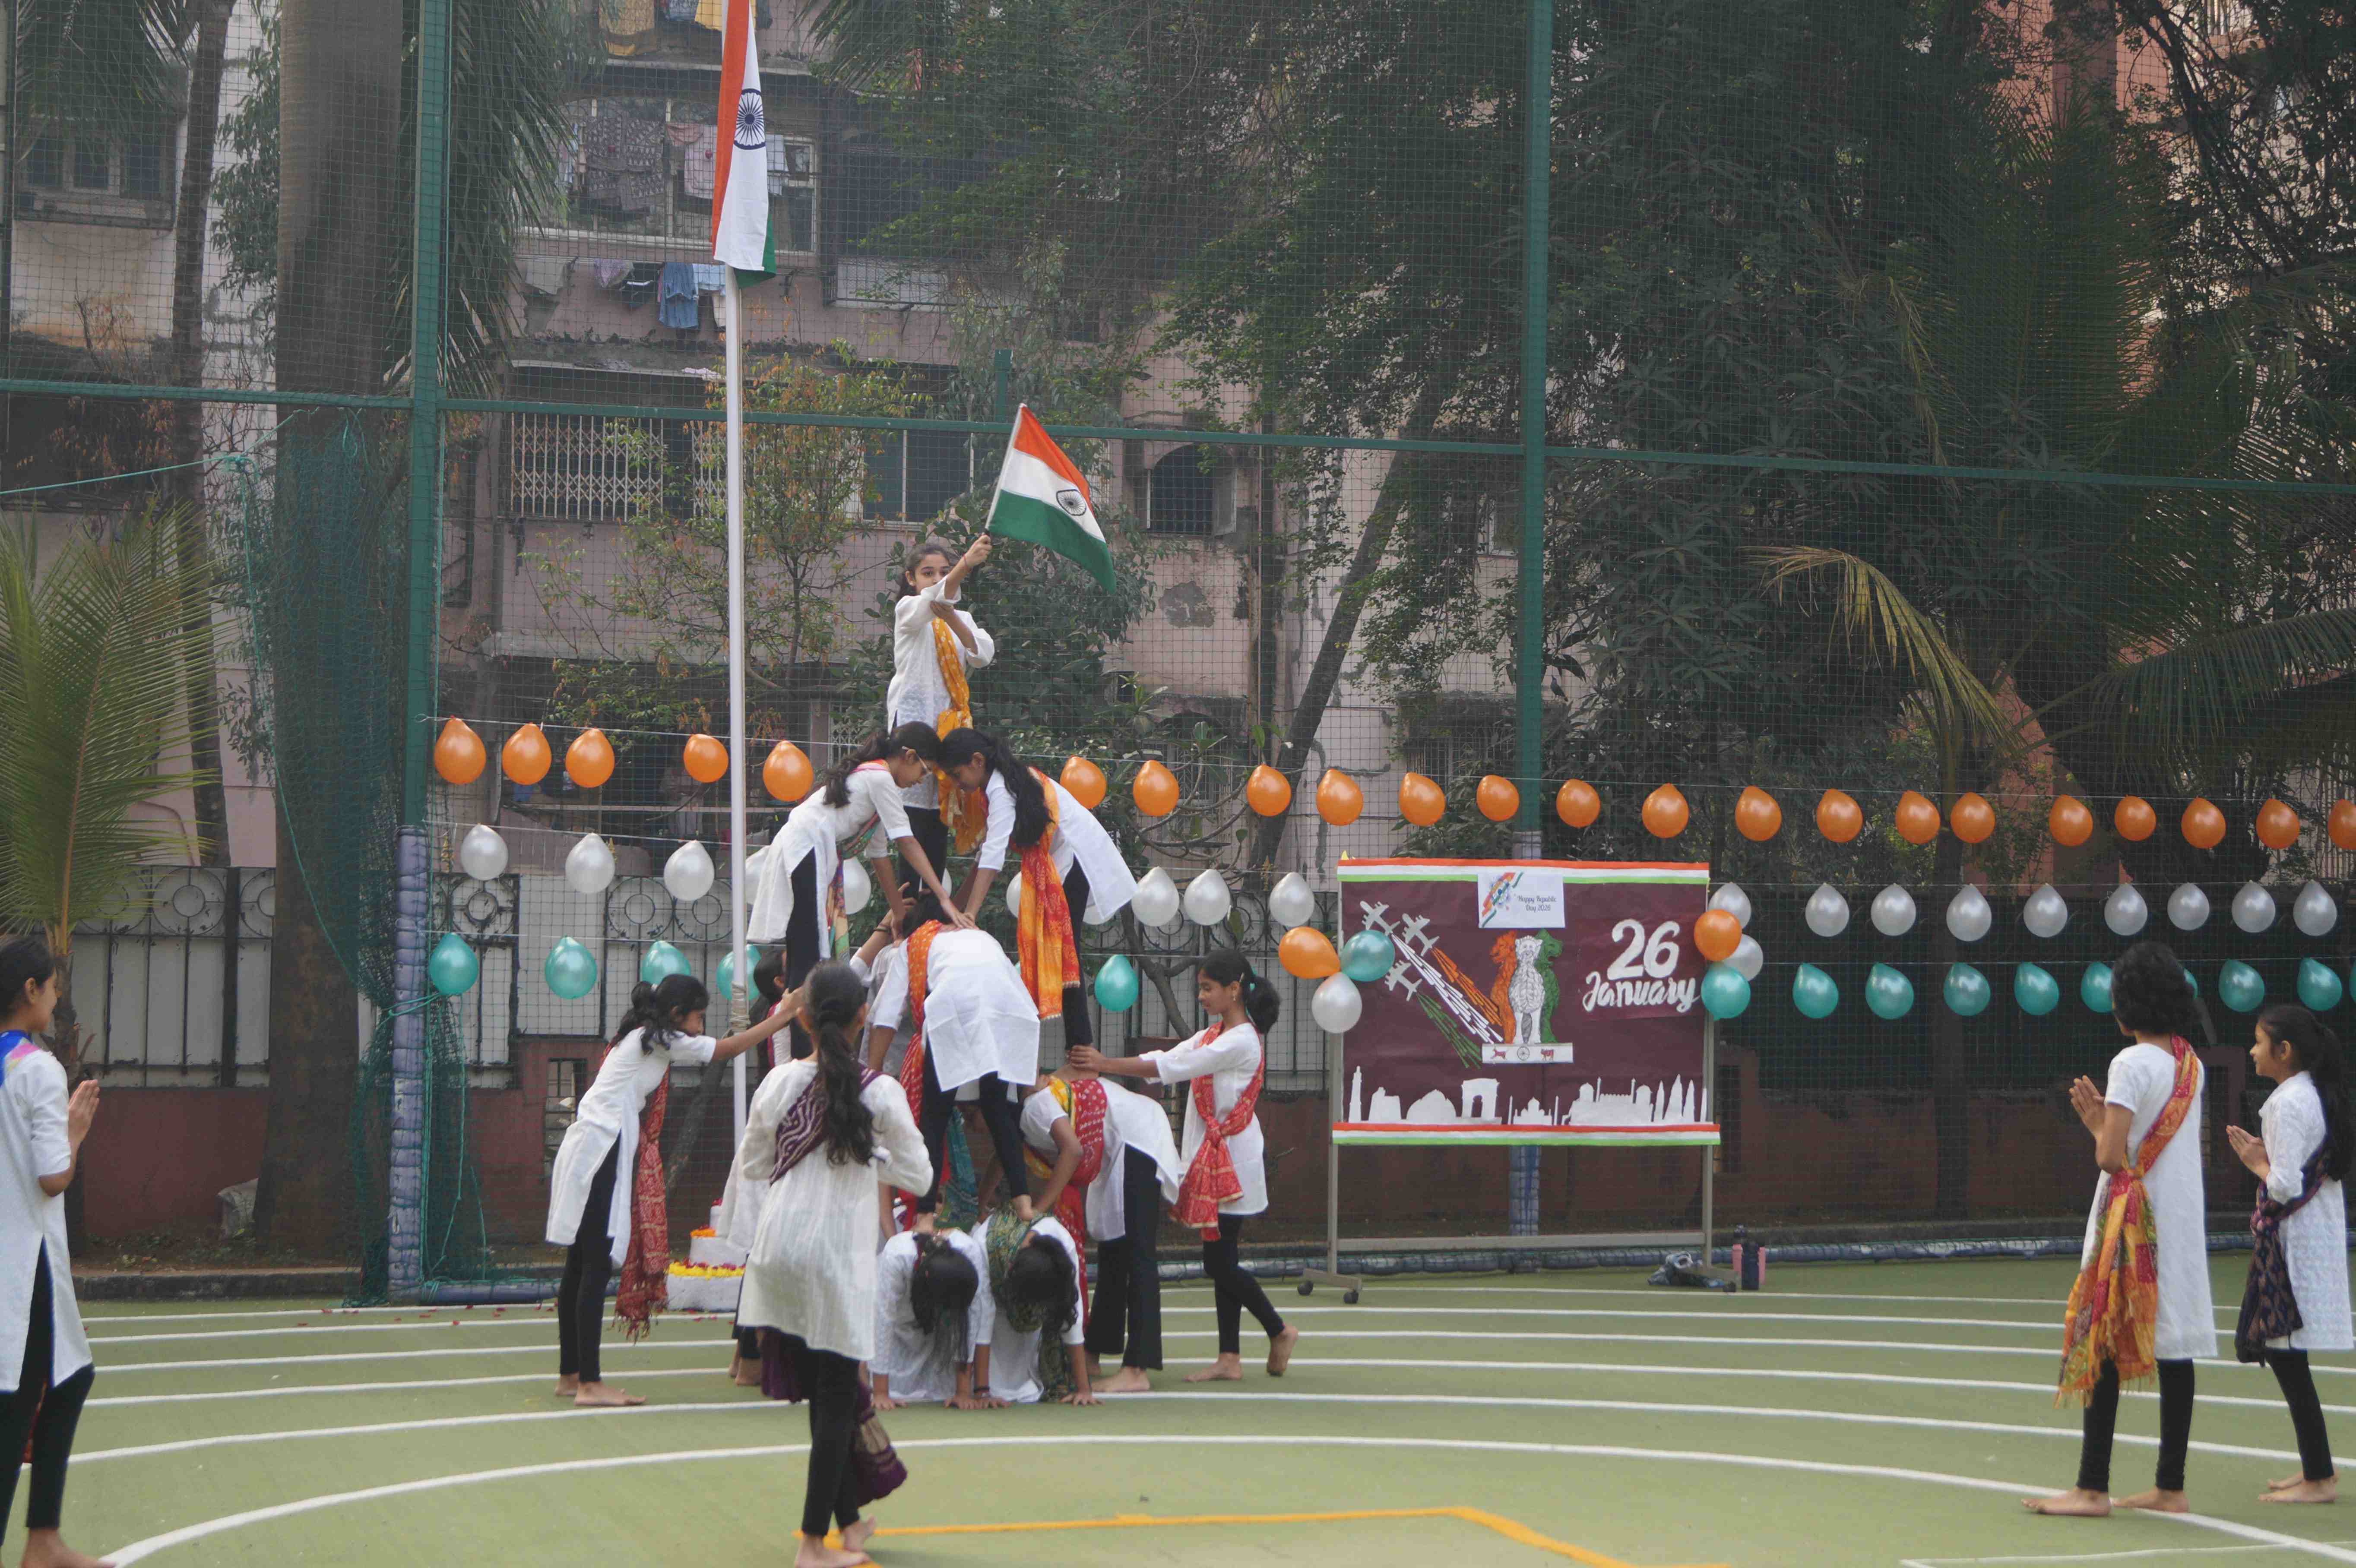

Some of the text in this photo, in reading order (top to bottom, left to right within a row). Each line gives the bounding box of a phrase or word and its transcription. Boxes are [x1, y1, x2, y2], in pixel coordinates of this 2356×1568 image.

[1517, 895, 1556, 903] Happy Republic
[1526, 904, 1536, 913] Day
[1607, 919, 1680, 980] 26
[1582, 971, 1700, 1013] January
